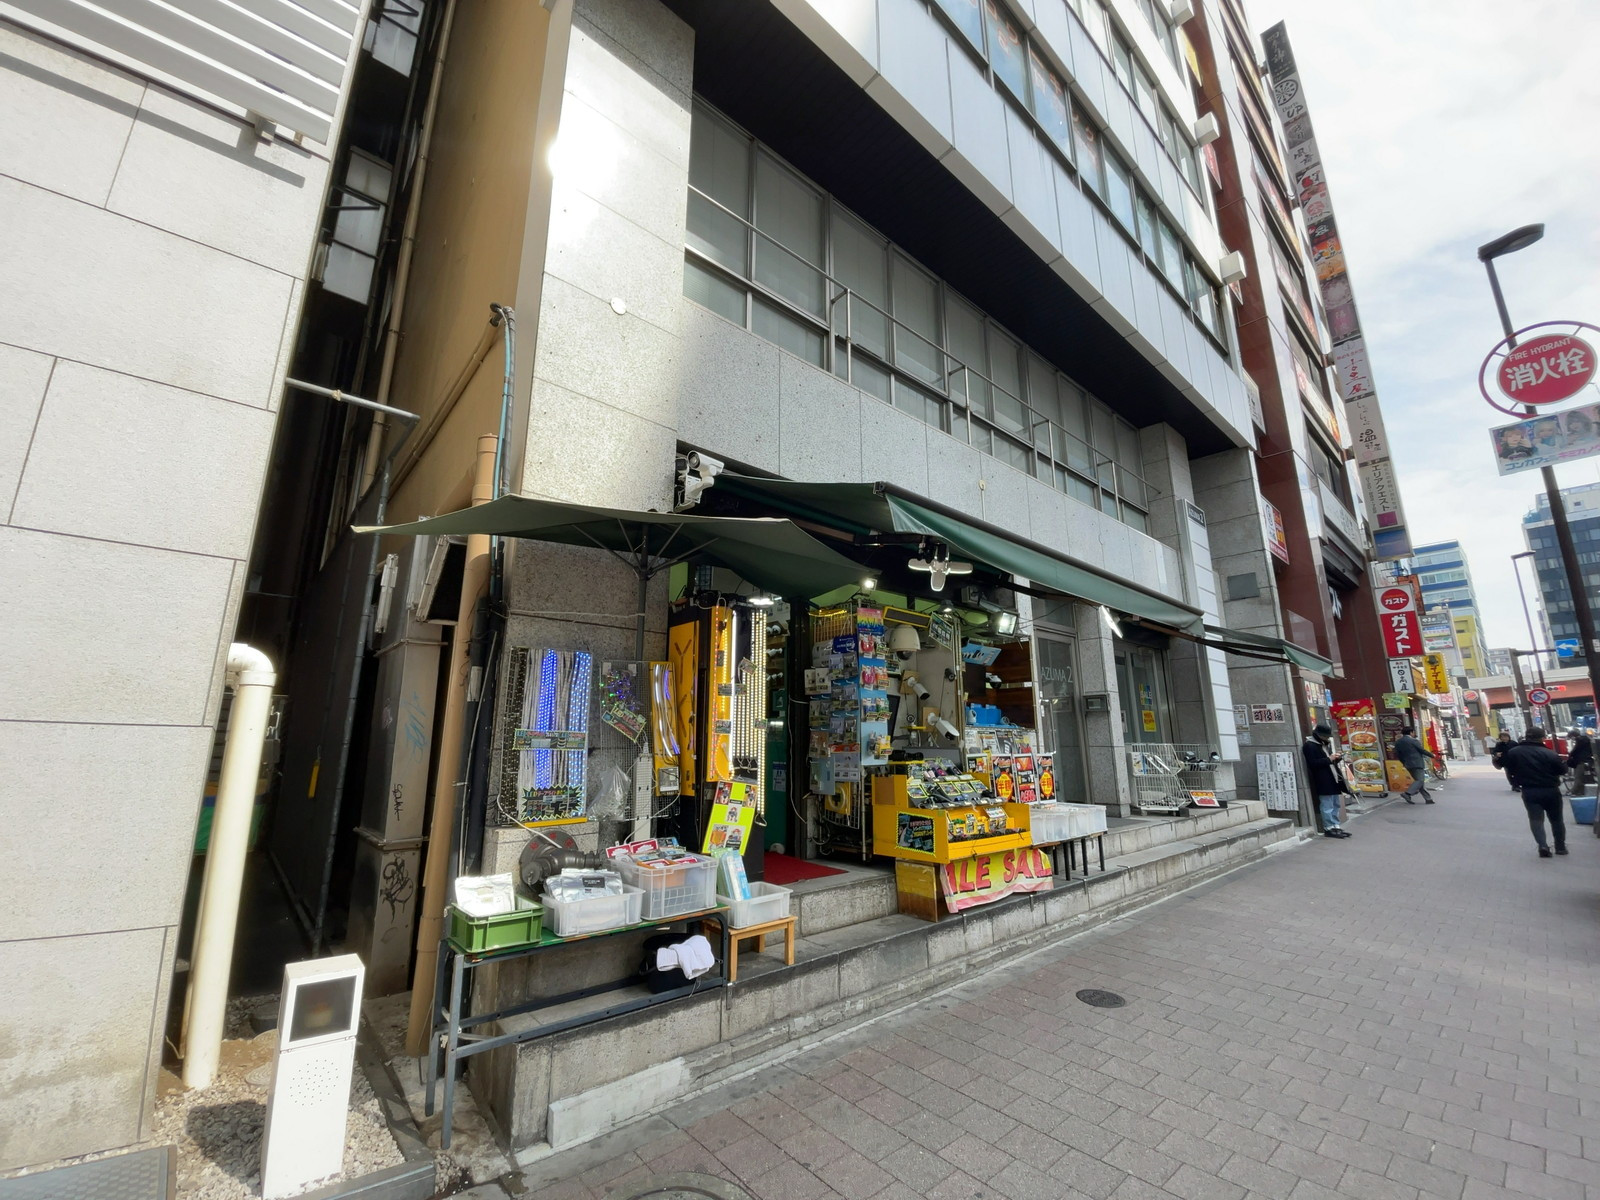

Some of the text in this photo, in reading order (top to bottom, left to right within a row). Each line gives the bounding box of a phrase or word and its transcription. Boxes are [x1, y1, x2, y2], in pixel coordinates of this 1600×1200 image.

[1286, 104, 1304, 119] UP
[1508, 337, 1572, 362] FIRE HYDRANT
[1504, 347, 1590, 392] 消火栓
[1371, 464, 1390, 512] エリアクエスト
[1384, 597, 1407, 605] ガスト
[1391, 613, 1411, 654] ガスト
[1040, 665, 1074, 683] AZUMA 2
[1254, 709, 1284, 722] 町役場
